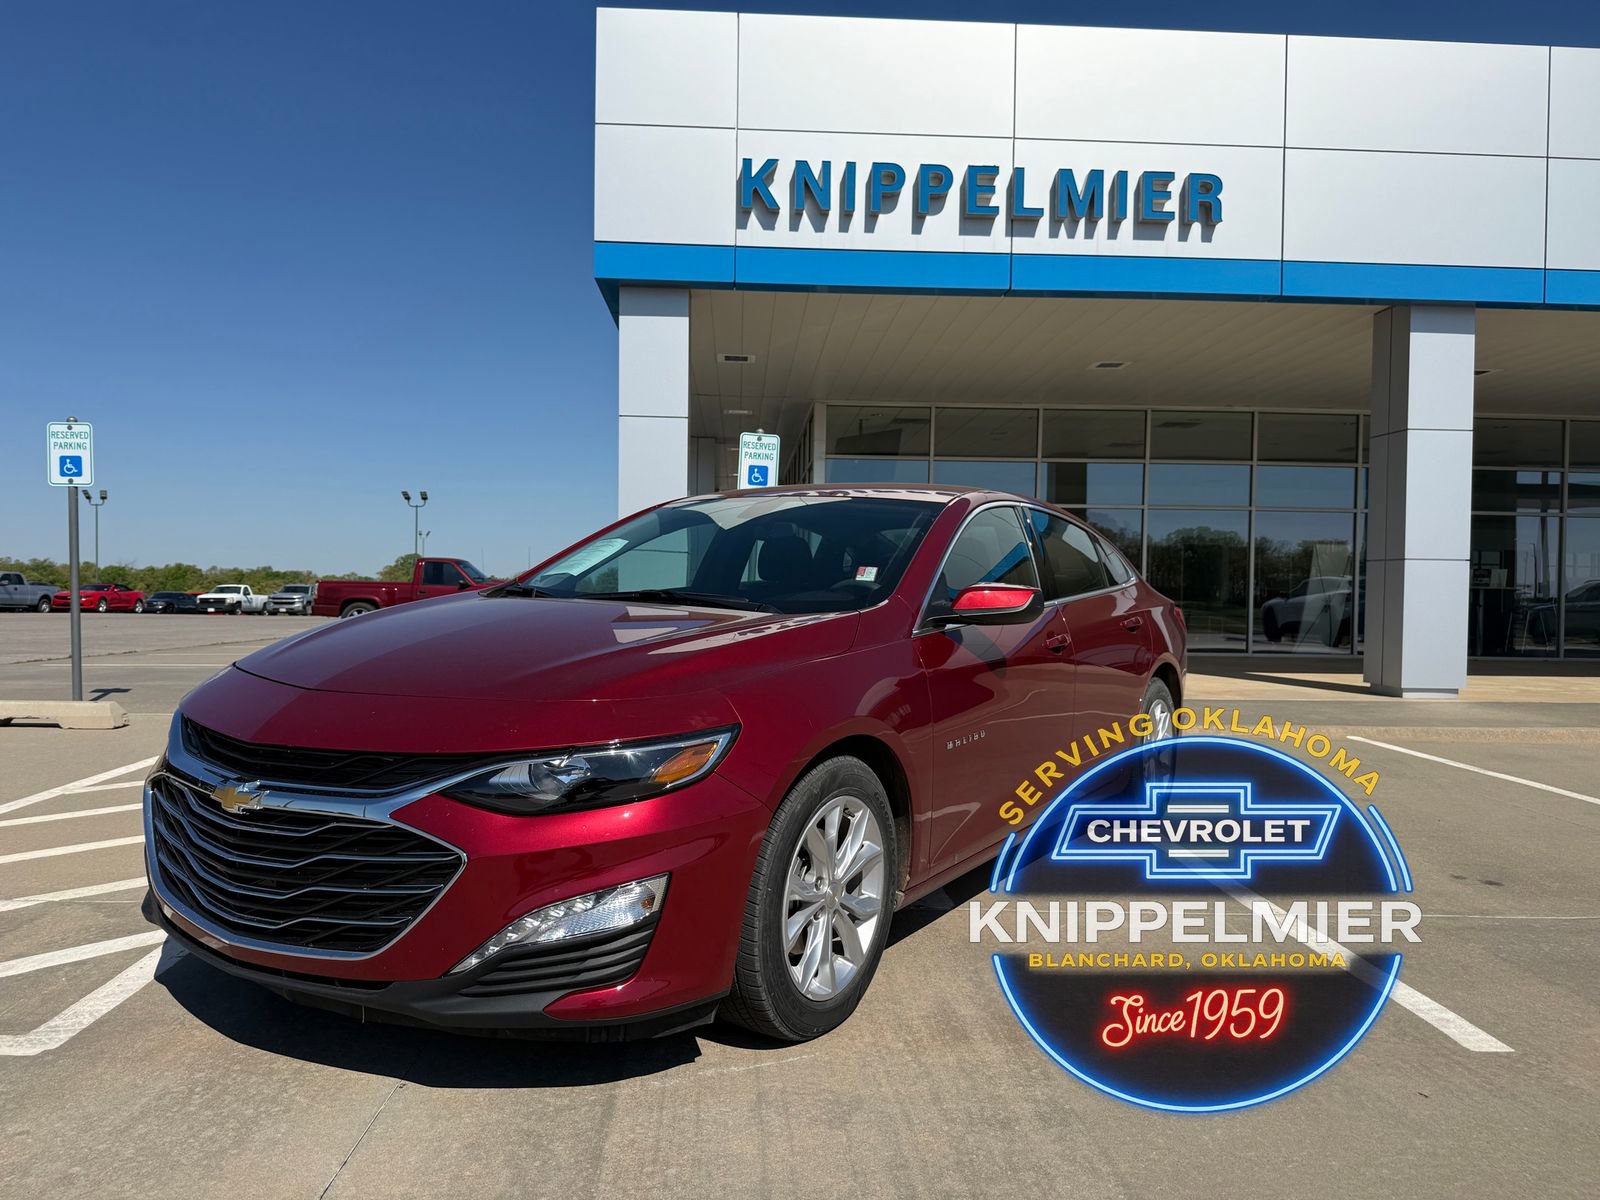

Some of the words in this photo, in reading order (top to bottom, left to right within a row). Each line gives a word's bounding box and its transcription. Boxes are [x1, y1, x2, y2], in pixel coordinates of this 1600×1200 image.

[738, 158, 1223, 224] KNIPPELMIER
[51, 430, 89, 439] RESERVED
[53, 441, 87, 450] PARKING
[743, 441, 776, 451] RESERVED
[744, 451, 774, 461] PARKING
